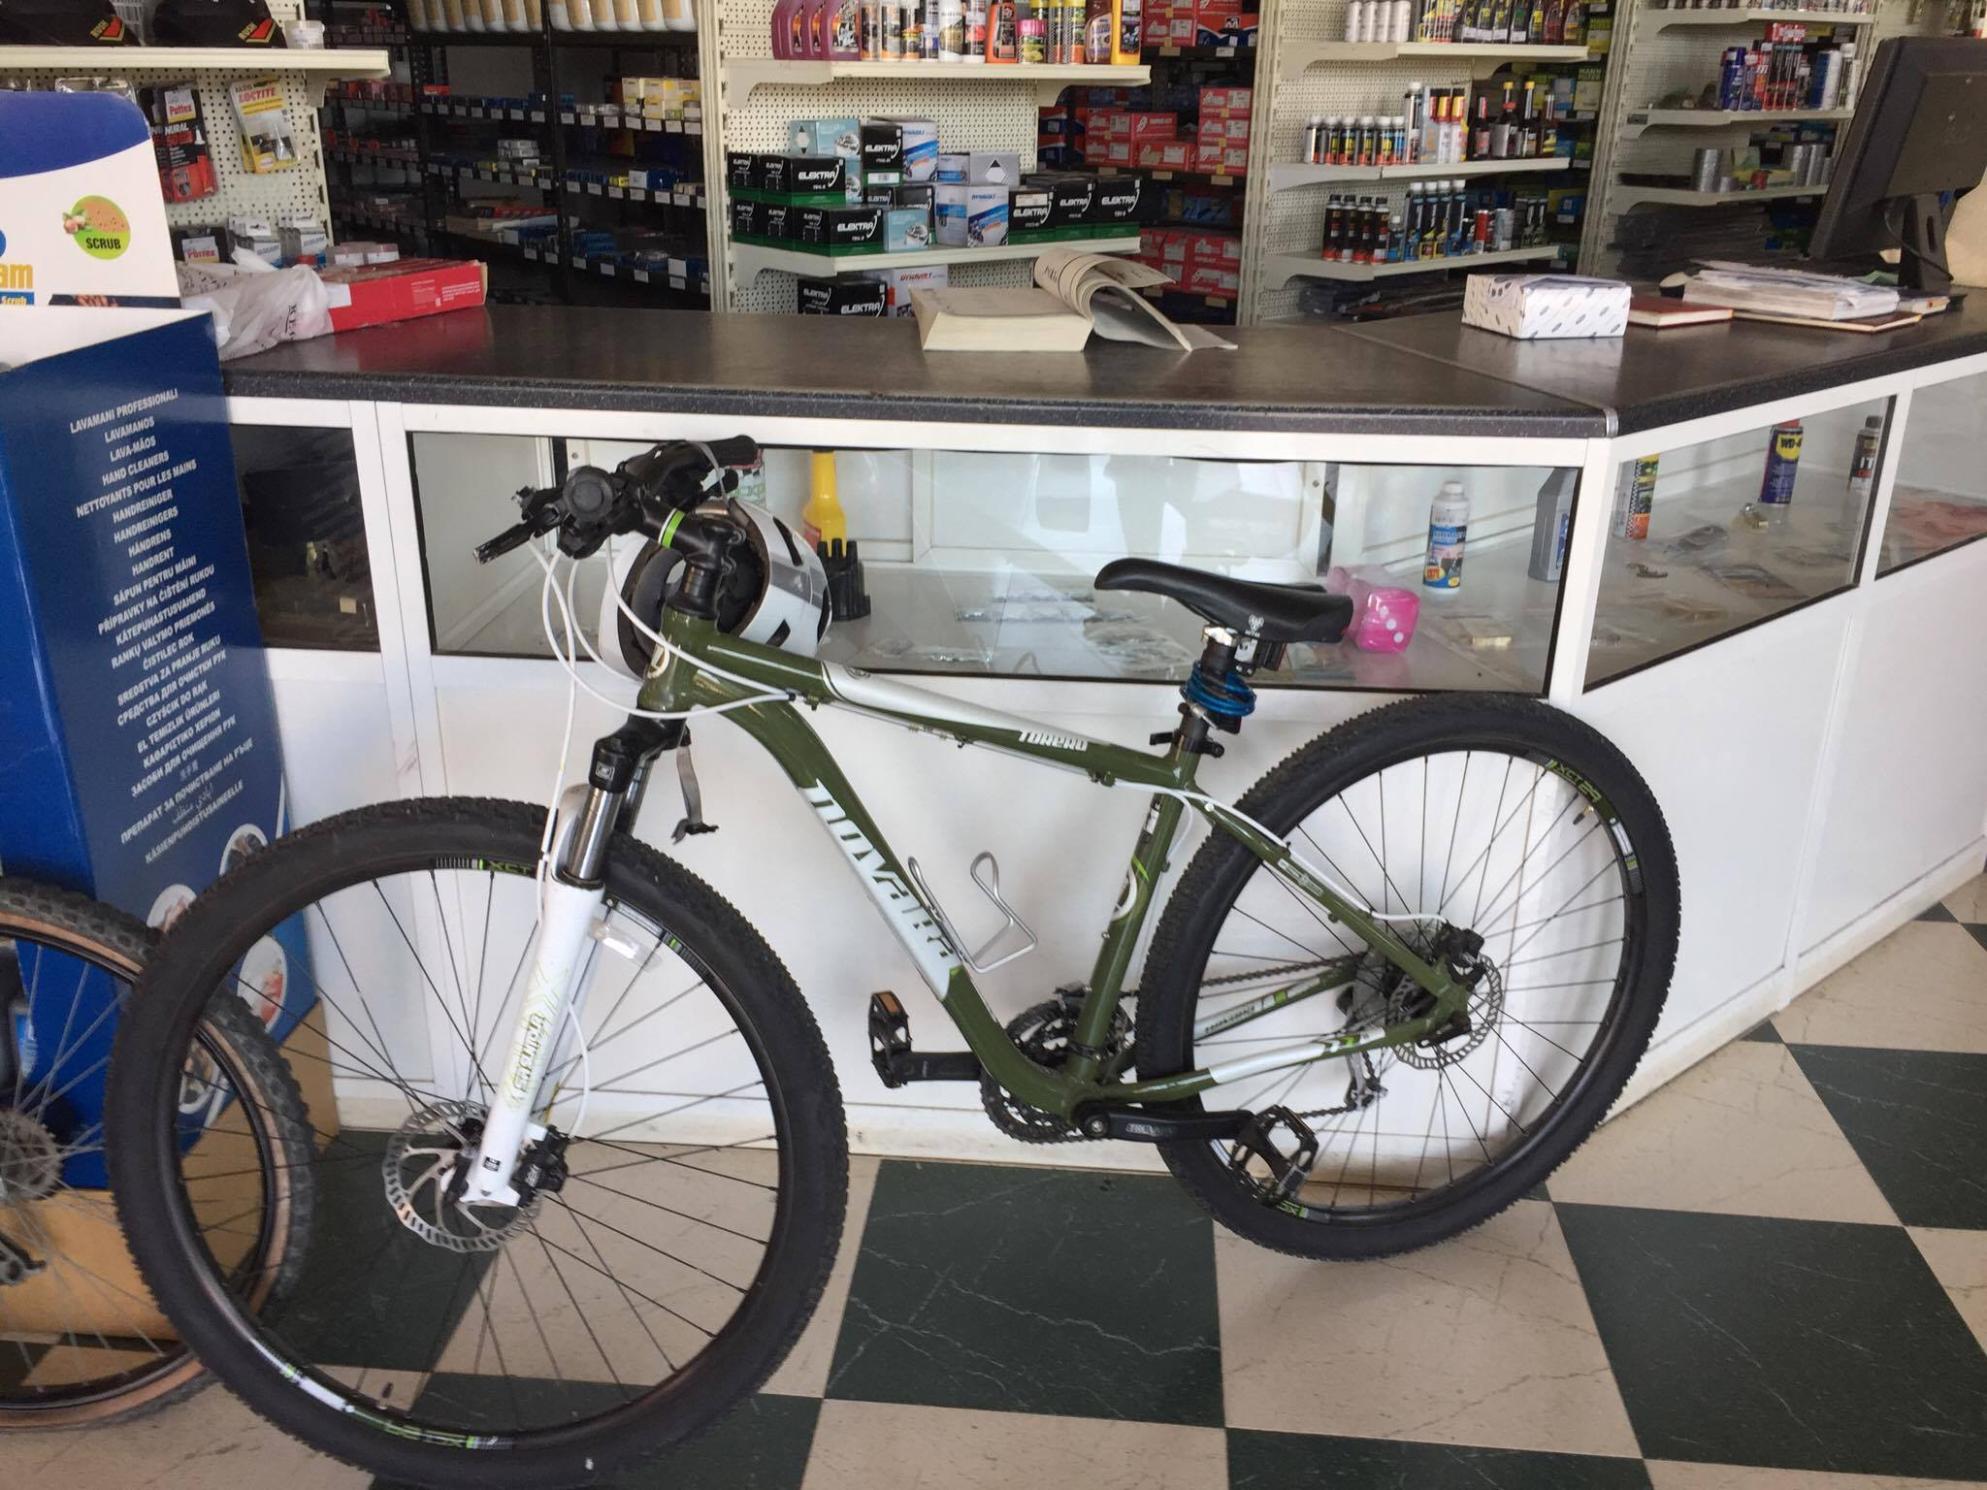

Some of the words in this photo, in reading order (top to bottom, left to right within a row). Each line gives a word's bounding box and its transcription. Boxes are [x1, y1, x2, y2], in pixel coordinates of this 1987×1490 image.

[239, 87, 276, 102] LOCTITE
[86, 237, 121, 250] SCRUB
[70, 409, 115, 433] LAVAMANI
[117, 388, 178, 418] PROFESSIONALI
[105, 416, 154, 442] LAVAMANOS
[110, 436, 156, 461] LAVA-MÃOS
[102, 470, 126, 485] HAND
[128, 451, 169, 476] CLEANERS
[77, 485, 132, 518] NETTOYANTS
[134, 476, 156, 494] POUR
[157, 470, 172, 484] LES
[173, 459, 196, 479] MAINS
[113, 489, 173, 523] HANDREINIGER
[114, 507, 178, 543] HANDREINIGERS
[132, 547, 174, 576] HANDRENT
[144, 567, 174, 592] PENTRU
[147, 595, 158, 609] NA
[190, 564, 214, 585] RUKOU
[142, 626, 174, 650] VALYMO
[143, 642, 177, 670] ČISTILEC
[179, 632, 194, 649] ROK
[118, 674, 159, 706] SREDSTVA
[161, 667, 171, 680] ZA
[171, 646, 200, 672] PRANJE
[201, 635, 221, 655] RUKU
[118, 693, 160, 726] СРЕДСТВА
[161, 680, 178, 701] ДЛЯ
[178, 659, 212, 688] ОЧИСТКИ
[213, 650, 226, 667] РУК
[181, 692, 191, 705] DO
[131, 768, 164, 798] ЗАСОБИ
[164, 755, 181, 778] ДЛЯ
[223, 714, 237, 731] РУК
[137, 739, 148, 753] EL
[121, 808, 163, 844] ПРЕПАРАТ
[164, 798, 174, 812] ЗА
[224, 754, 233, 767] НА
